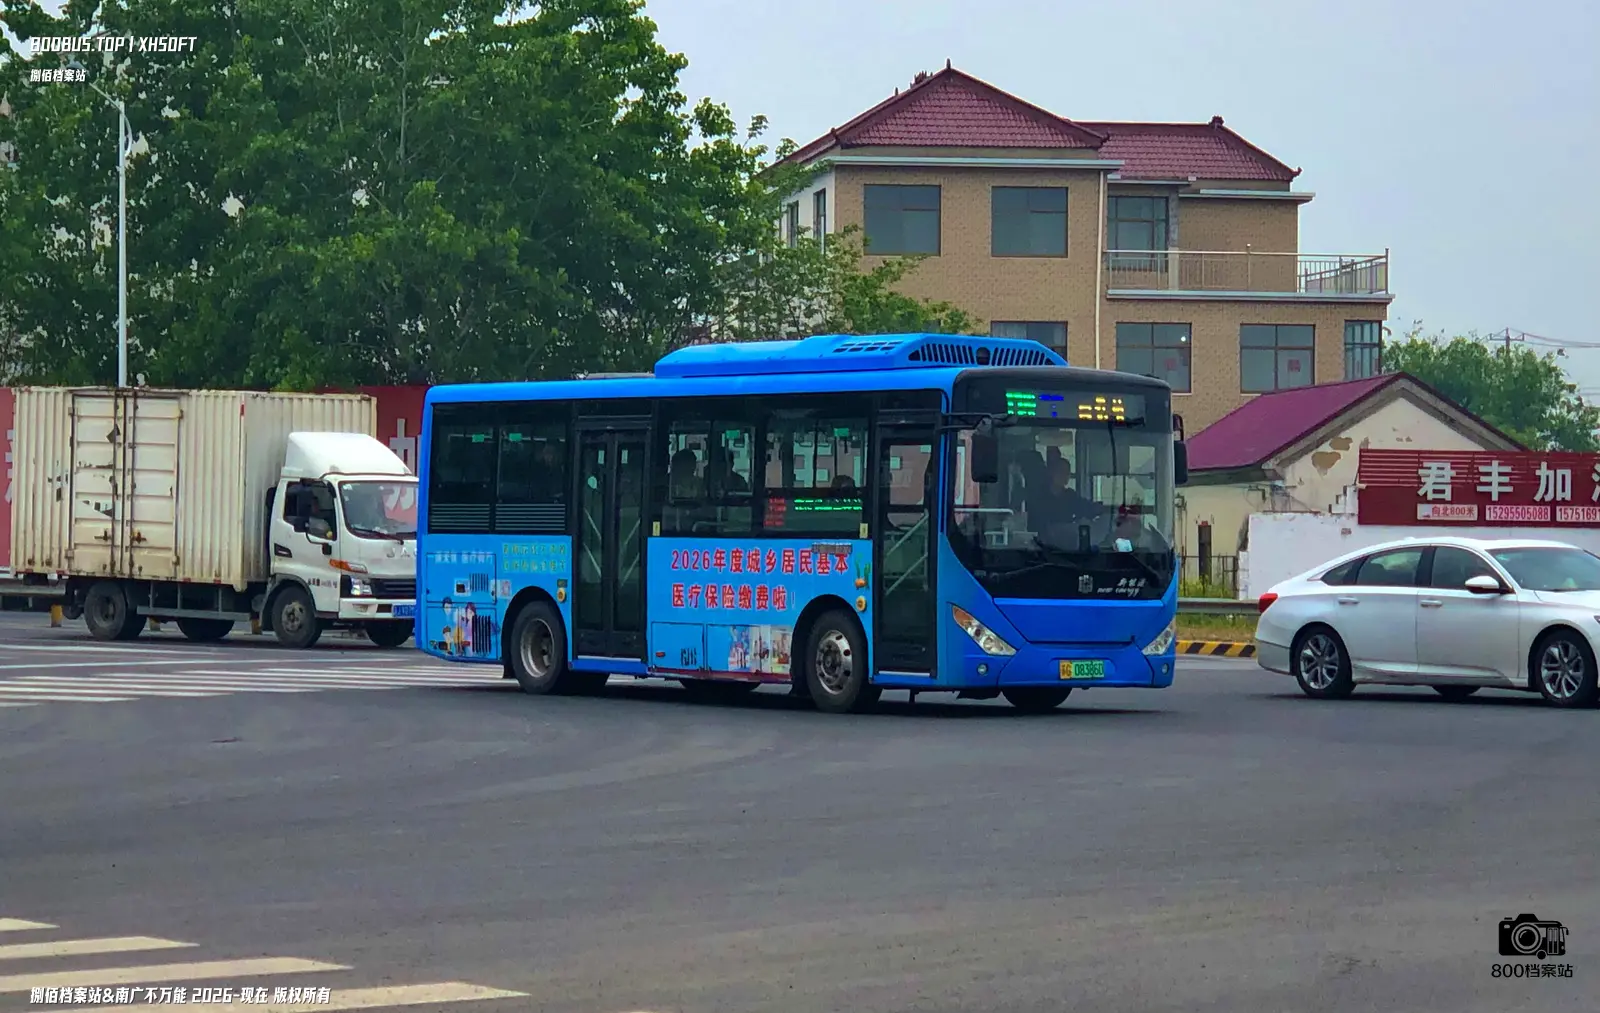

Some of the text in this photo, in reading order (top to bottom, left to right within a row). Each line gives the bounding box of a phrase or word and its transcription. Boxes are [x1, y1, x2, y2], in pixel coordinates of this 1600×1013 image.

[1417, 460, 1600, 502] 君丰加
[1432, 505, 1475, 518] 向北800米
[1487, 506, 1549, 520] 15295505088
[386, 547, 418, 558] JA
